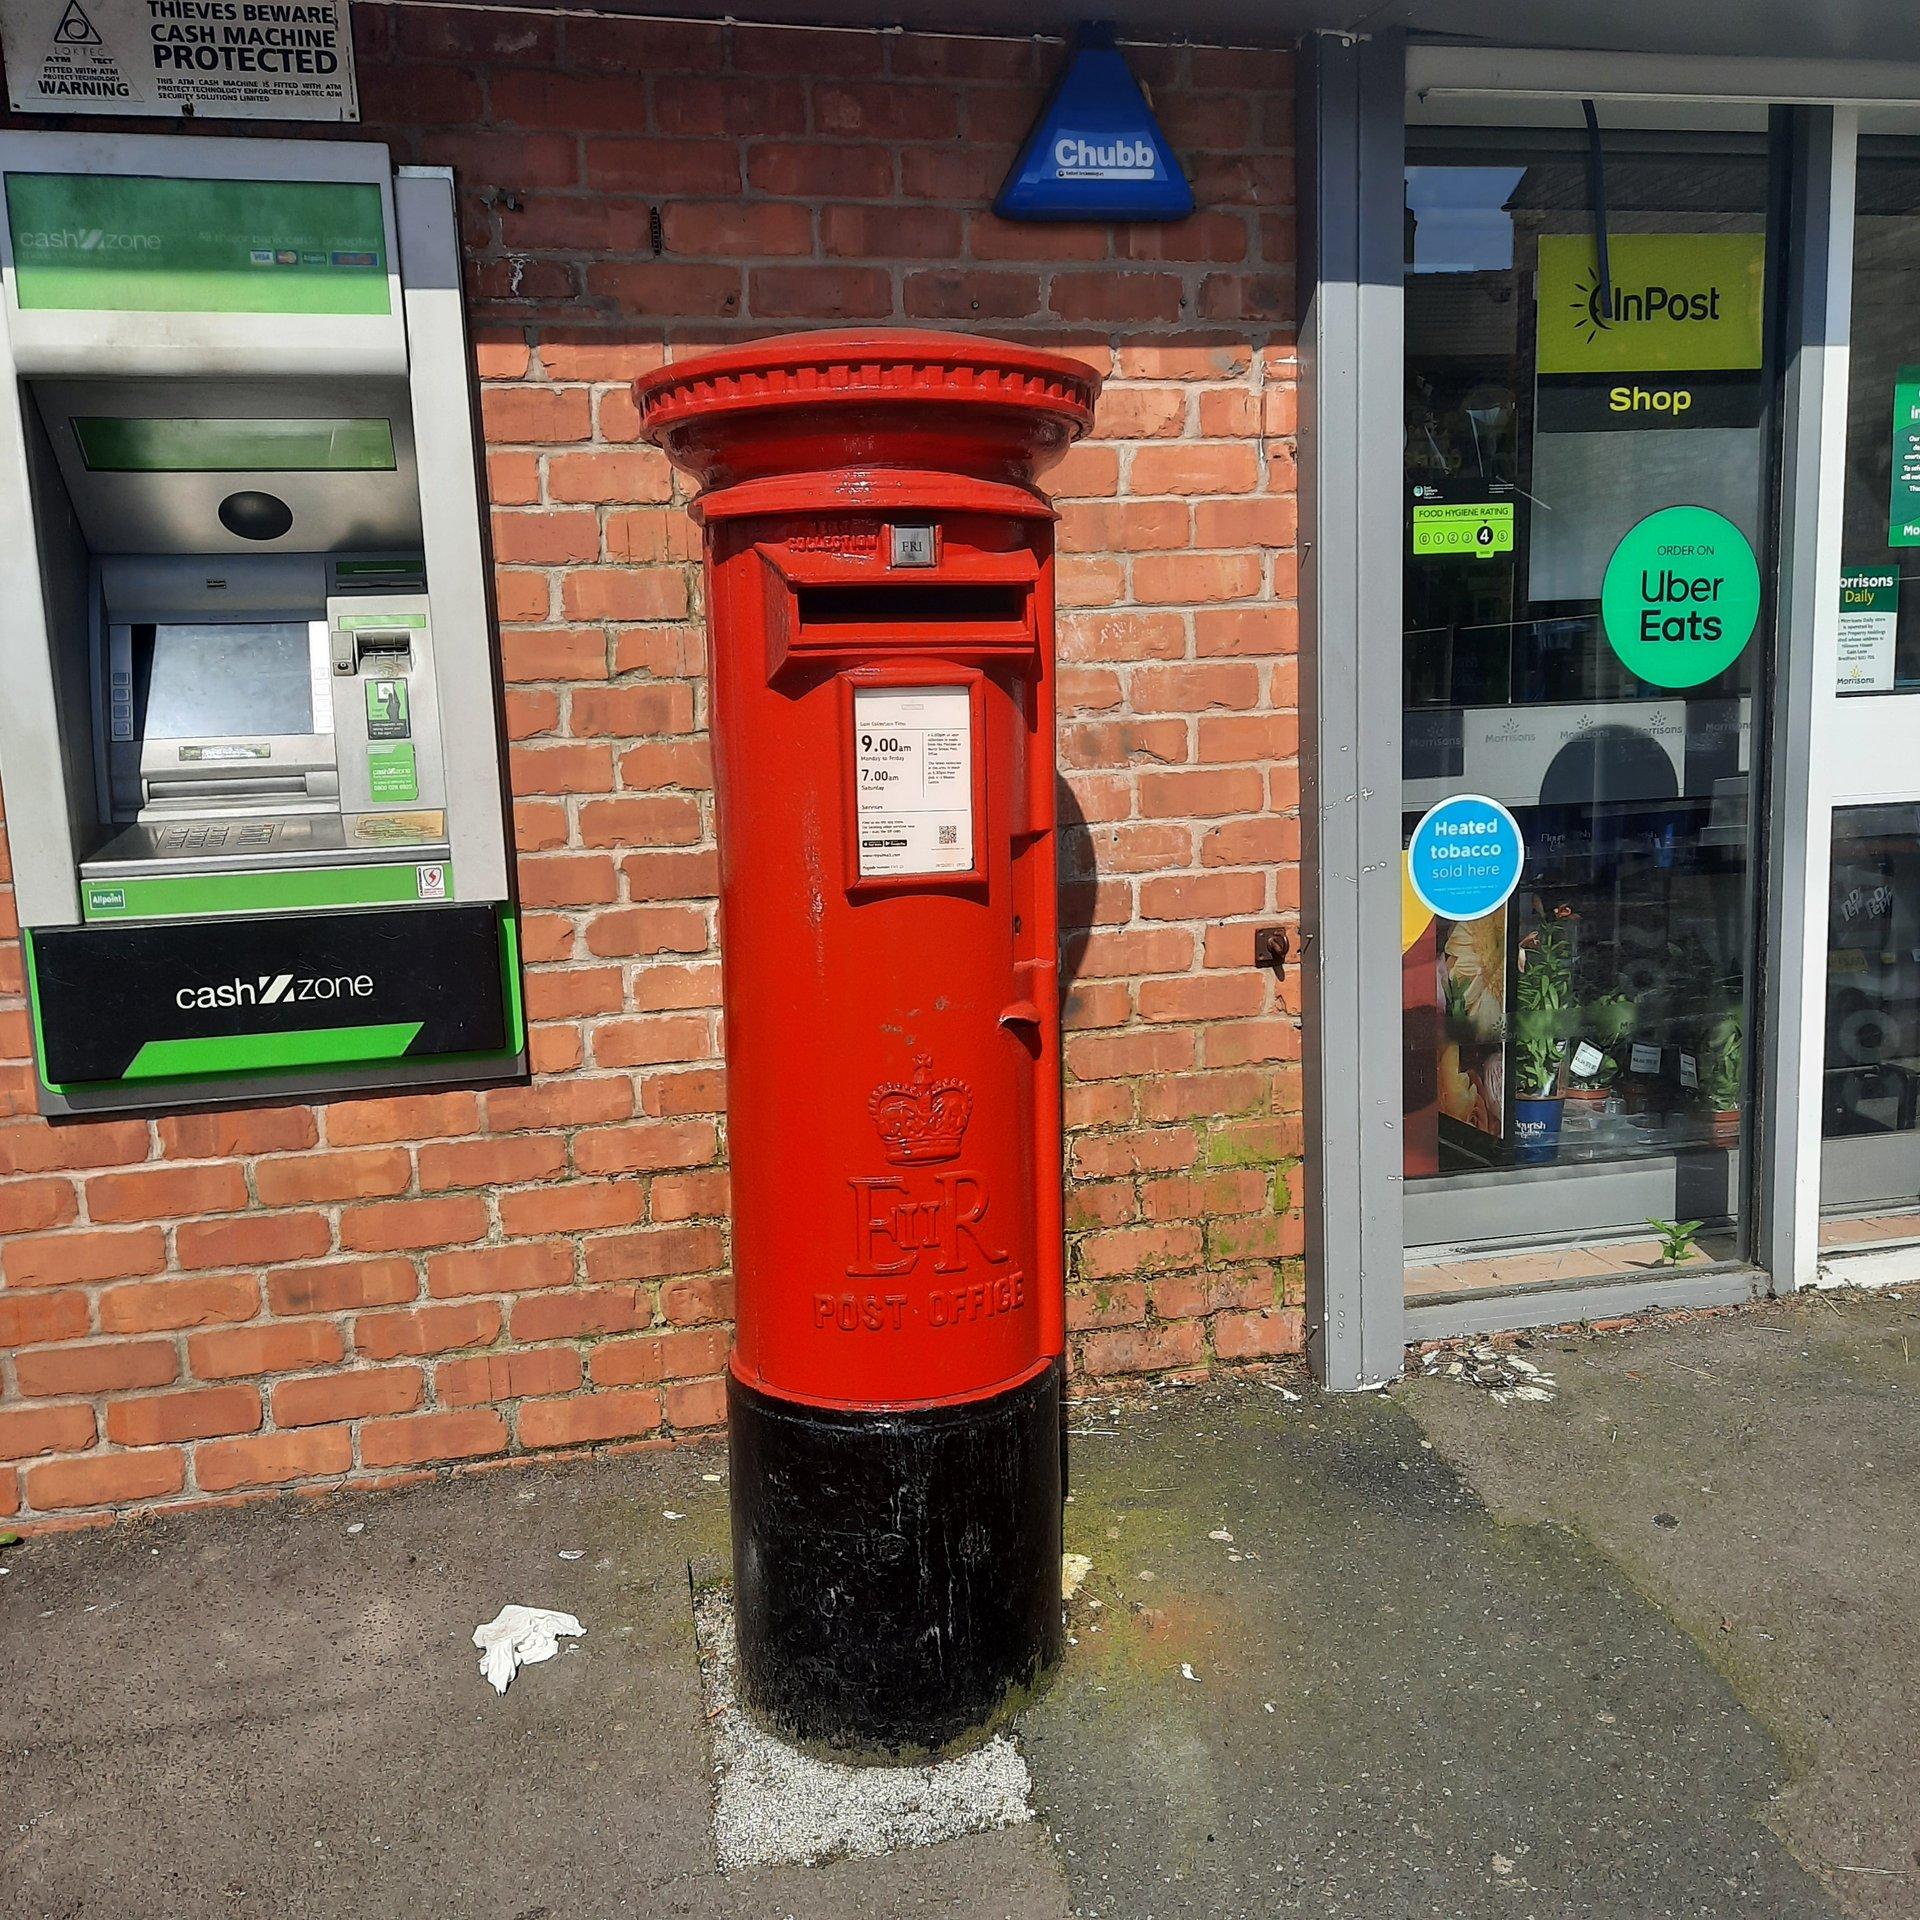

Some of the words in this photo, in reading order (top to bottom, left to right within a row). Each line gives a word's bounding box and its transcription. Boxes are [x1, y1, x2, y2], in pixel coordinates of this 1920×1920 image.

[147, 0, 237, 20] THIEVES
[243, 4, 334, 23] BEWARE
[151, 24, 215, 43] CASH
[223, 26, 336, 48] MACHINE
[153, 44, 338, 74] PROTECTED
[44, 66, 72, 74] FITTED
[74, 67, 97, 75] WITH
[75, 74, 120, 82] TECHNOLOGY
[38, 80, 129, 96] WARNING
[192, 86, 241, 94] TECHNOLOGY
[302, 82, 321, 90] WITH
[196, 93, 238, 101] SOLUTIONS
[1055, 139, 1154, 167] Chubb
[20, 229, 78, 249] cash
[106, 234, 161, 250] zone
[1614, 286, 1720, 321] InPost
[1609, 386, 1692, 416] Shop
[1419, 509, 1443, 518] FOOD
[1445, 508, 1479, 517] HYGIENE
[1480, 507, 1508, 516] RATING
[788, 534, 878, 552] COLLECTION
[1479, 528, 1490, 543] 4
[1656, 545, 1695, 556] ORDER
[1696, 545, 1715, 556] ON
[1641, 570, 1725, 603] Uber
[1840, 573, 1894, 589] orrisons
[1845, 588, 1875, 606] Daily
[1640, 609, 1723, 642] Eats
[1837, 677, 1875, 685] Morrisons
[861, 734, 912, 752] 9.00am
[1485, 733, 1537, 744] Morrisons
[861, 769, 899, 781] 7.00am
[1435, 818, 1498, 836] Heated
[1430, 843, 1502, 859] tobacco
[1432, 864, 1463, 879] sold
[1467, 864, 1500, 877] here
[93, 893, 122, 906] Allpoint
[176, 977, 256, 1009] cash
[297, 975, 374, 1000] zone
[813, 1293, 908, 1332] POST
[926, 1271, 1025, 1328] OFFICE
